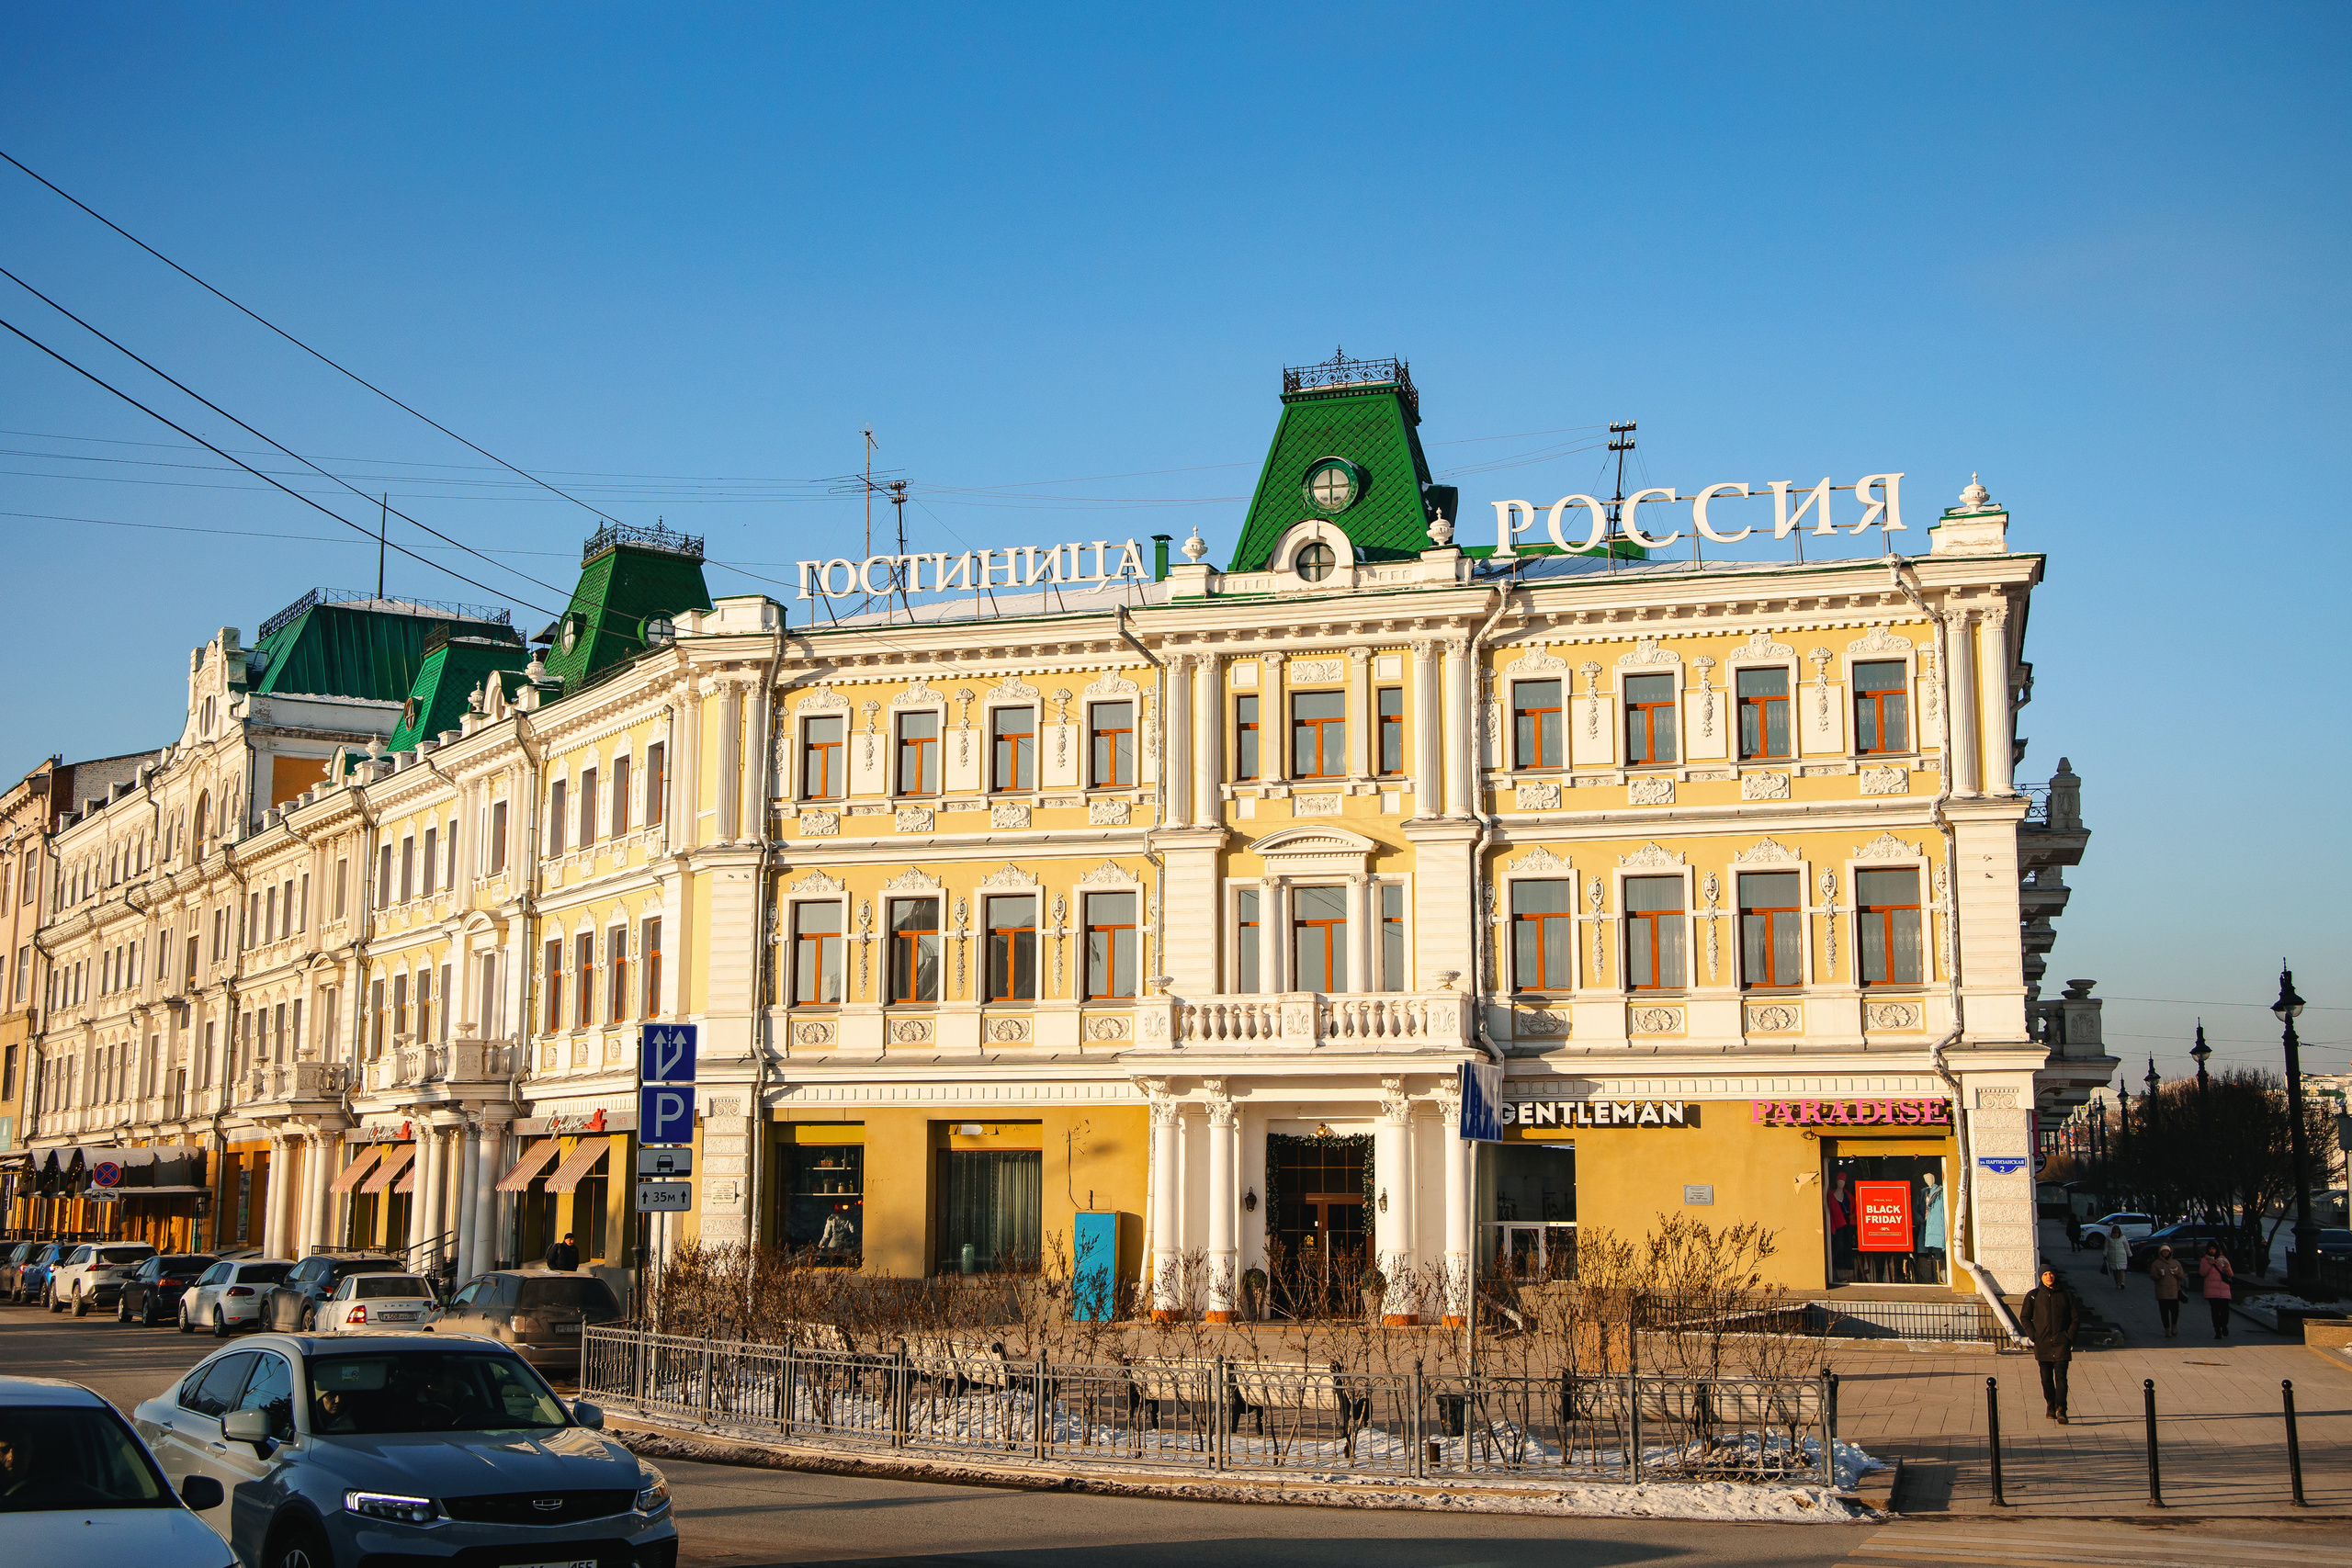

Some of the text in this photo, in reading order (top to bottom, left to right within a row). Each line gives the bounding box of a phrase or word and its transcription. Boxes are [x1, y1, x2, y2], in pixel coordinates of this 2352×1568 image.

[1490, 472, 1908, 557] РОССИЯ
[796, 537, 1150, 601] ГОСТИНИЦА
[655, 1092, 684, 1137] P
[1502, 1100, 1684, 1125] GENTLEMAN
[1749, 1098, 1948, 1123] PARADISE
[1865, 1215, 1903, 1224] FRIDAY
[1866, 1204, 1901, 1213] BLACK
